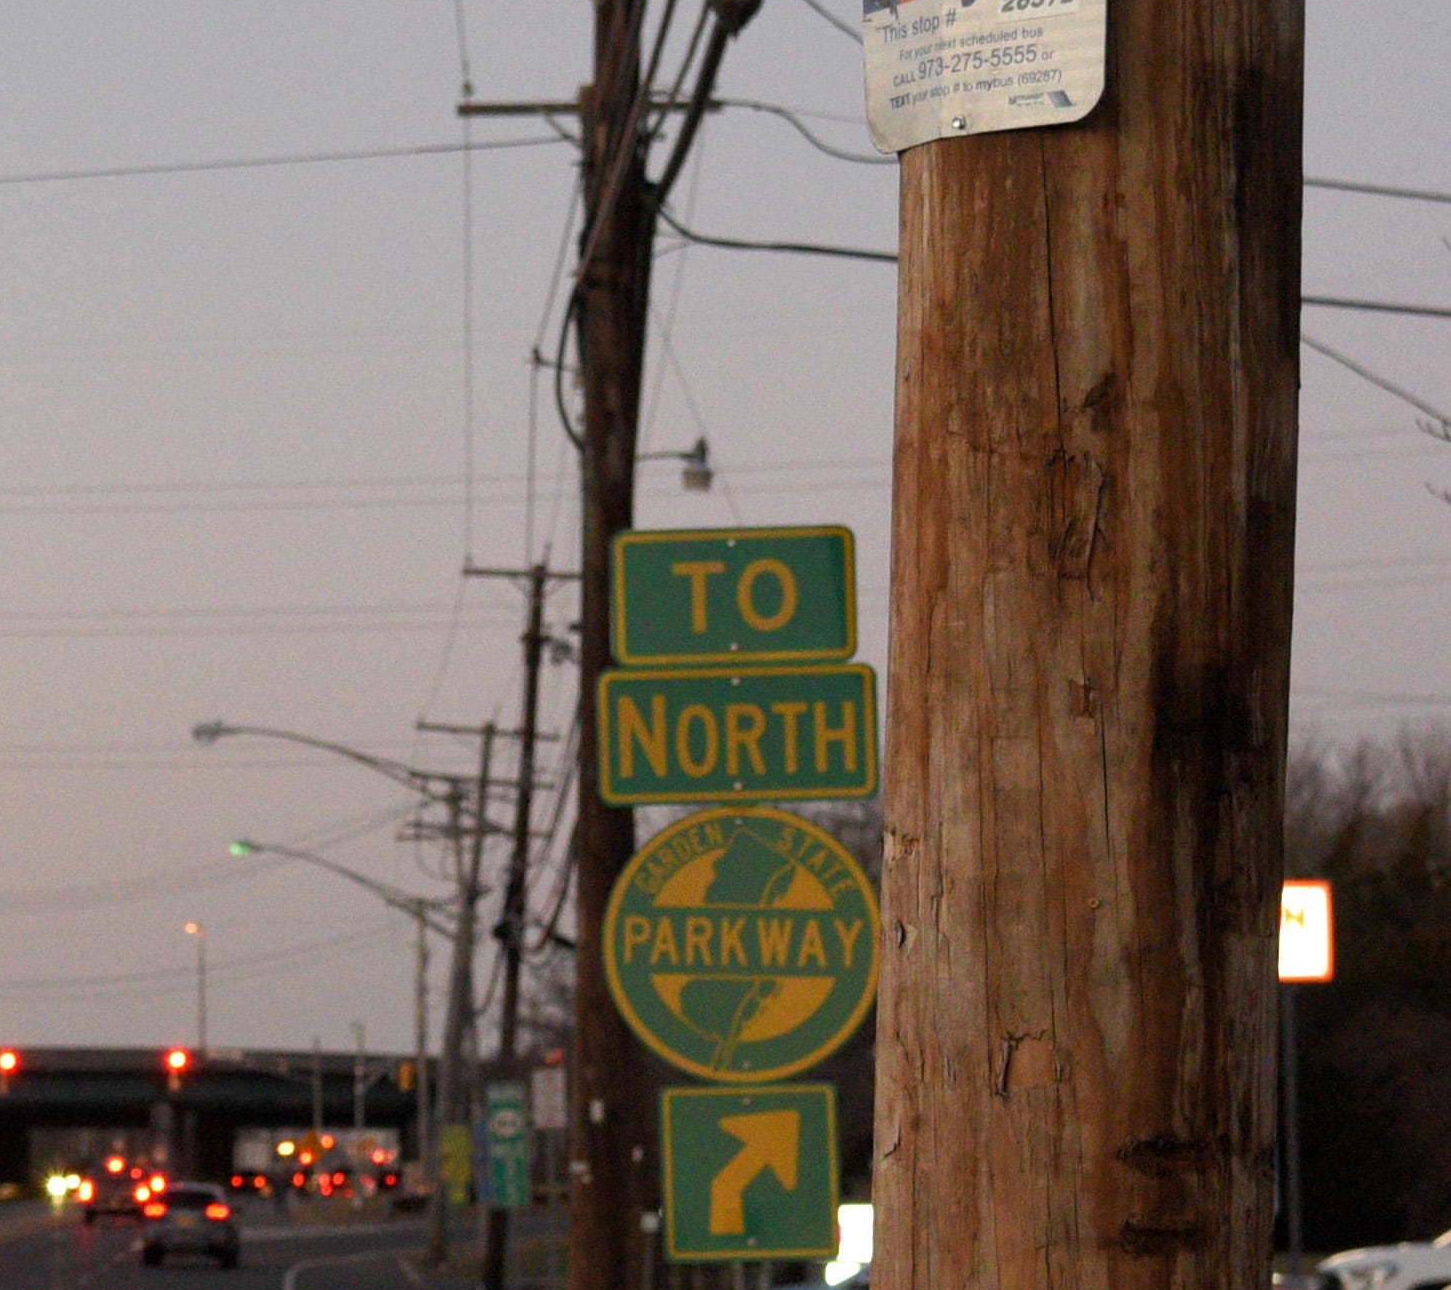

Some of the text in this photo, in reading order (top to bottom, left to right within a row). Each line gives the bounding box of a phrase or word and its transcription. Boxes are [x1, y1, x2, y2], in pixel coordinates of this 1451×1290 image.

[882, 24, 908, 44] This
[912, 16, 940, 37] stop
[959, 28, 1018, 48] scheduled
[1021, 26, 1044, 39] bus
[893, 73, 917, 88] CALL
[918, 43, 1038, 81] 973-275-5555
[975, 75, 1014, 93] mybus
[670, 558, 798, 634] TO
[617, 693, 857, 780] NORTH
[635, 820, 858, 901] GARDEN STATE
[622, 913, 864, 969] PARKWAY
